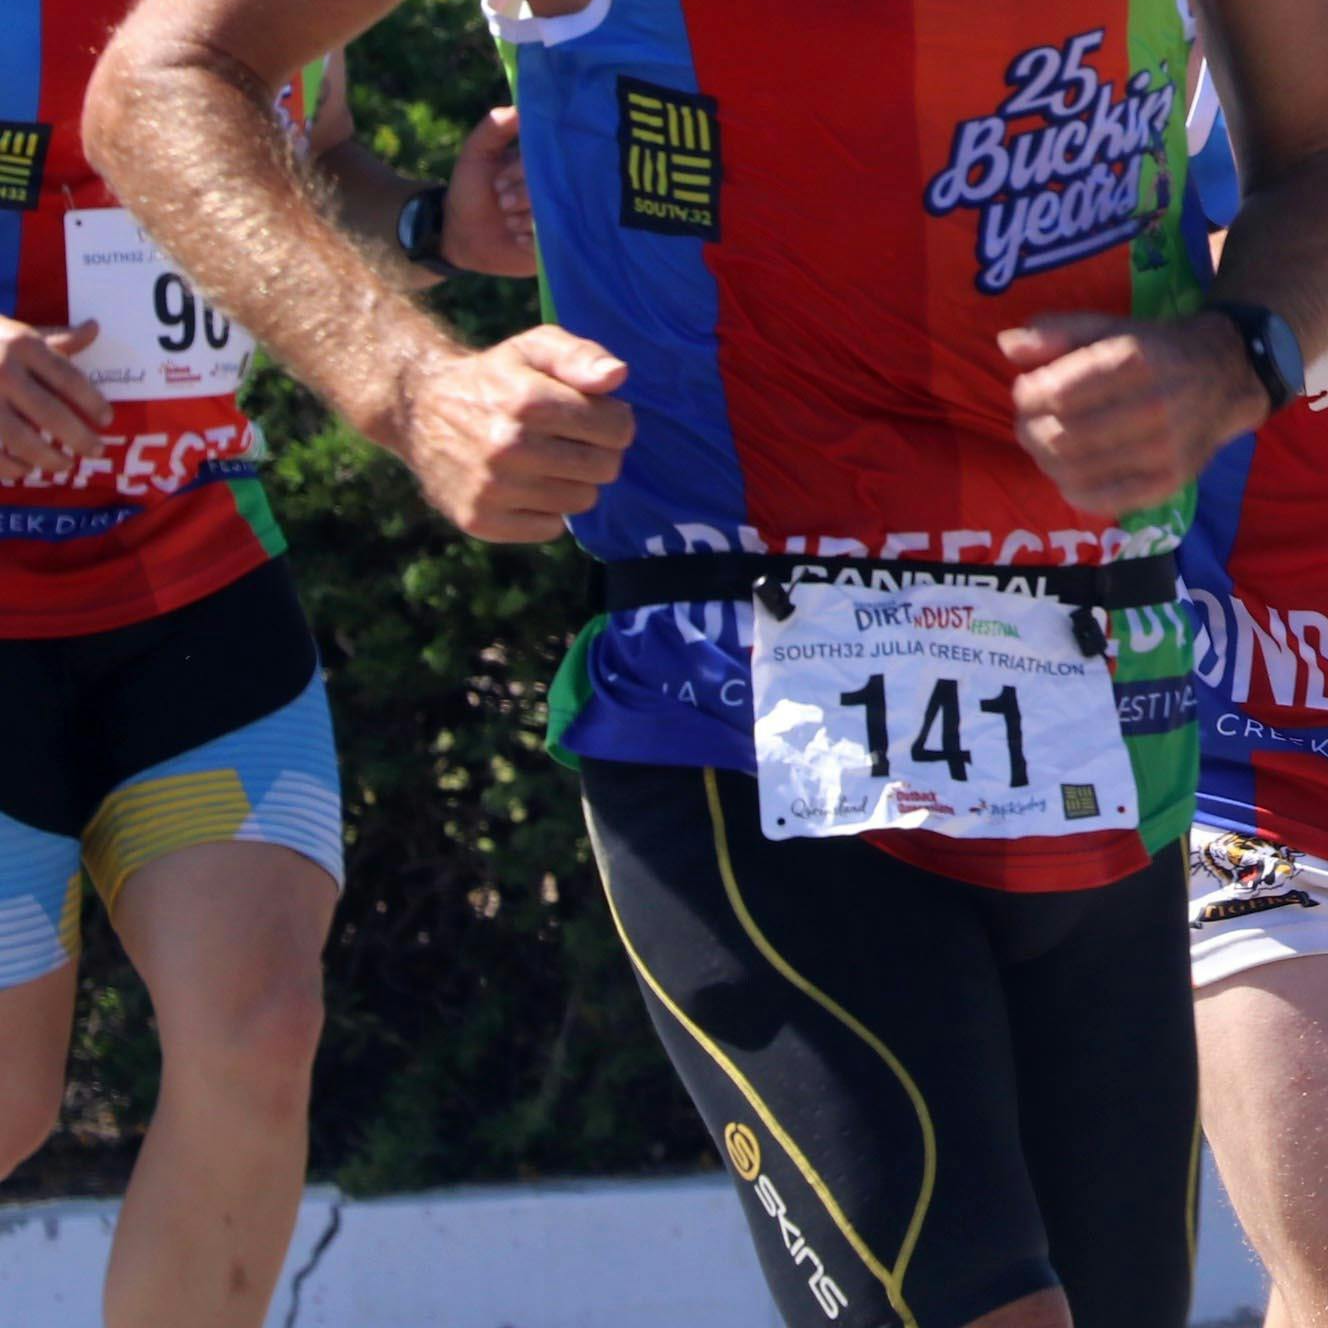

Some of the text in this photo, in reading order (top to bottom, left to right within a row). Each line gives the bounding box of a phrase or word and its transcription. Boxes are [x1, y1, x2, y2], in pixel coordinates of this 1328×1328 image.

[1003, 29, 1106, 117] 25
[773, 639, 1086, 677] SOUTH32 JULIA CREEK TRIATHLON
[853, 602, 914, 632] DIRT
[921, 605, 975, 630] DUST
[971, 620, 1021, 639] FESTIVAL
[840, 673, 1030, 788] 141
[754, 1173, 850, 1321] SKINS
